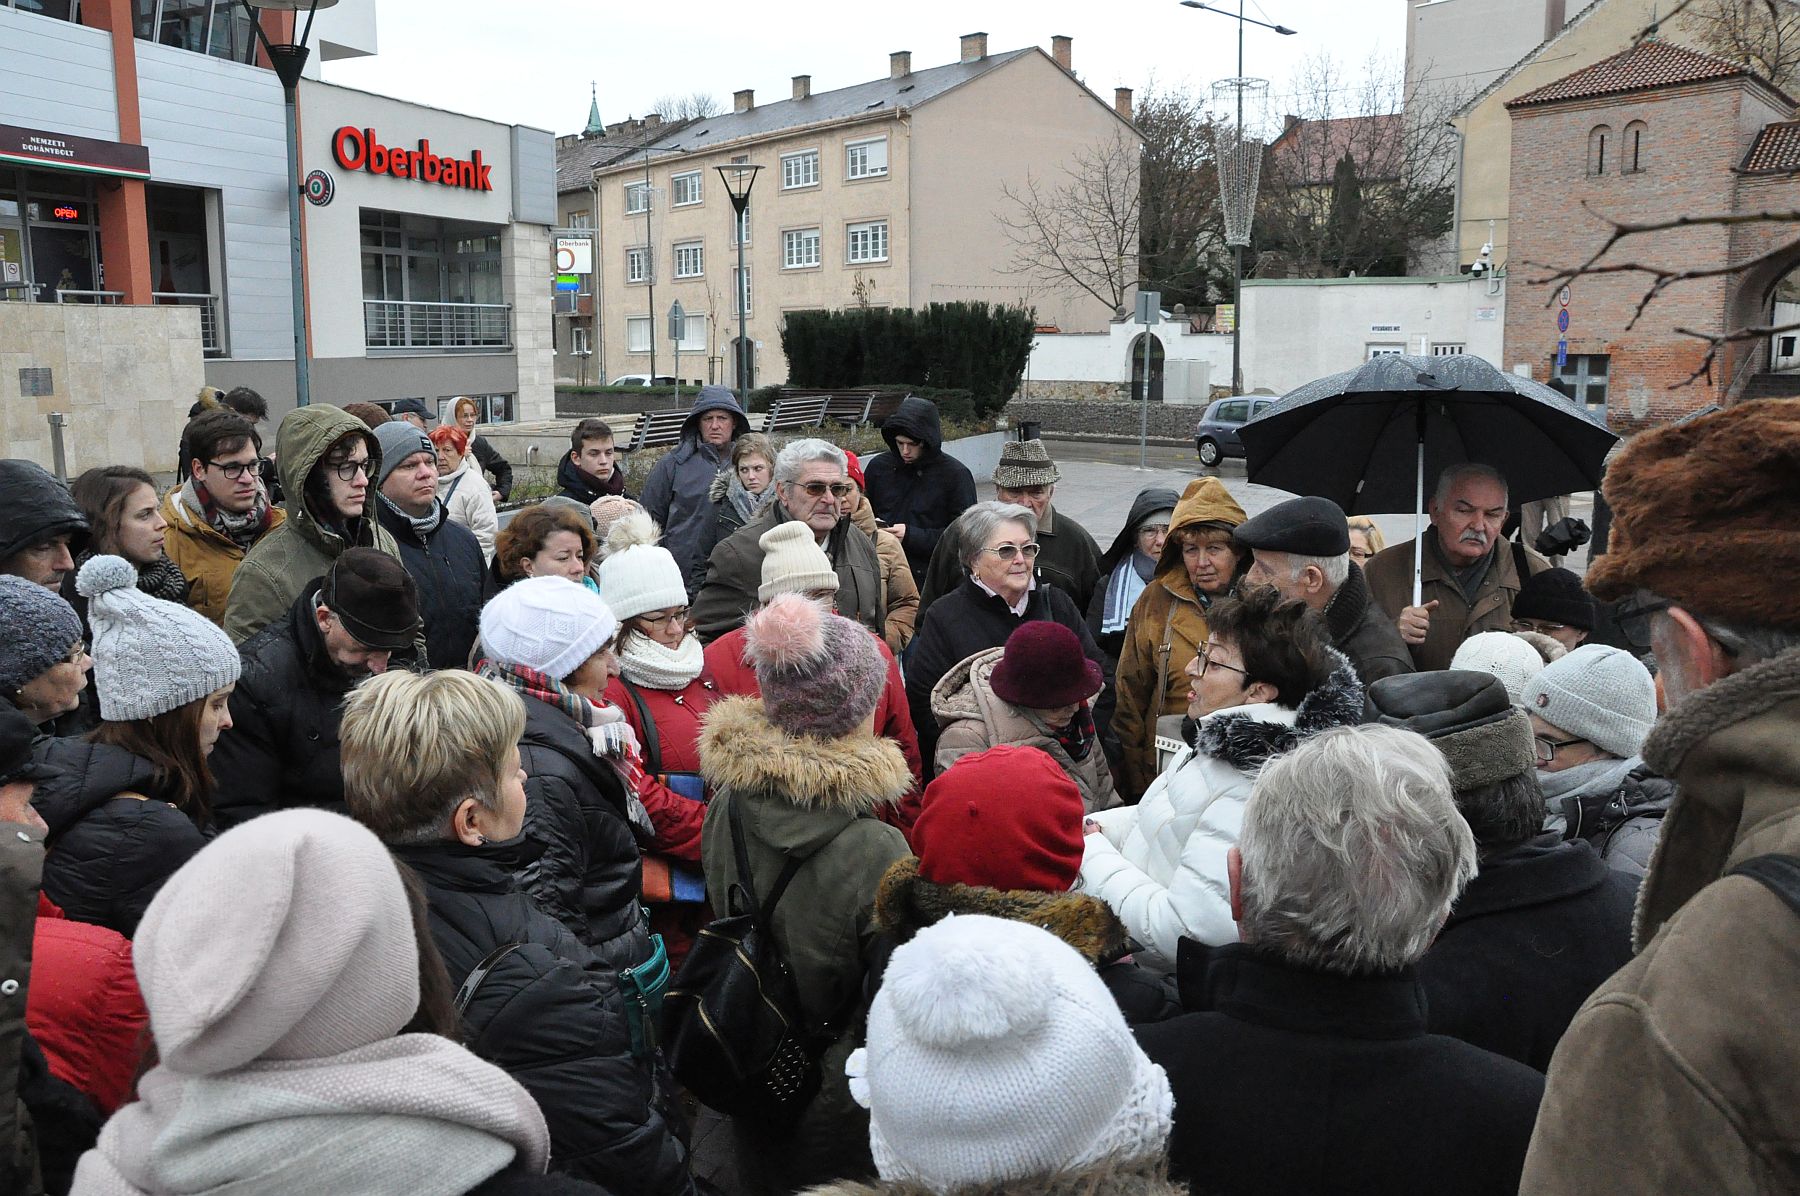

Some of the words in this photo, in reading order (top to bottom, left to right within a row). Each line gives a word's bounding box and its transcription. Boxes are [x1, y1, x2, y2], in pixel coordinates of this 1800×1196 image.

[30, 136, 66, 148] NEMZETI
[22, 143, 75, 157] DOHÁNYBOLT
[331, 126, 493, 191] Oberbank
[54, 207, 78, 219] OPEN
